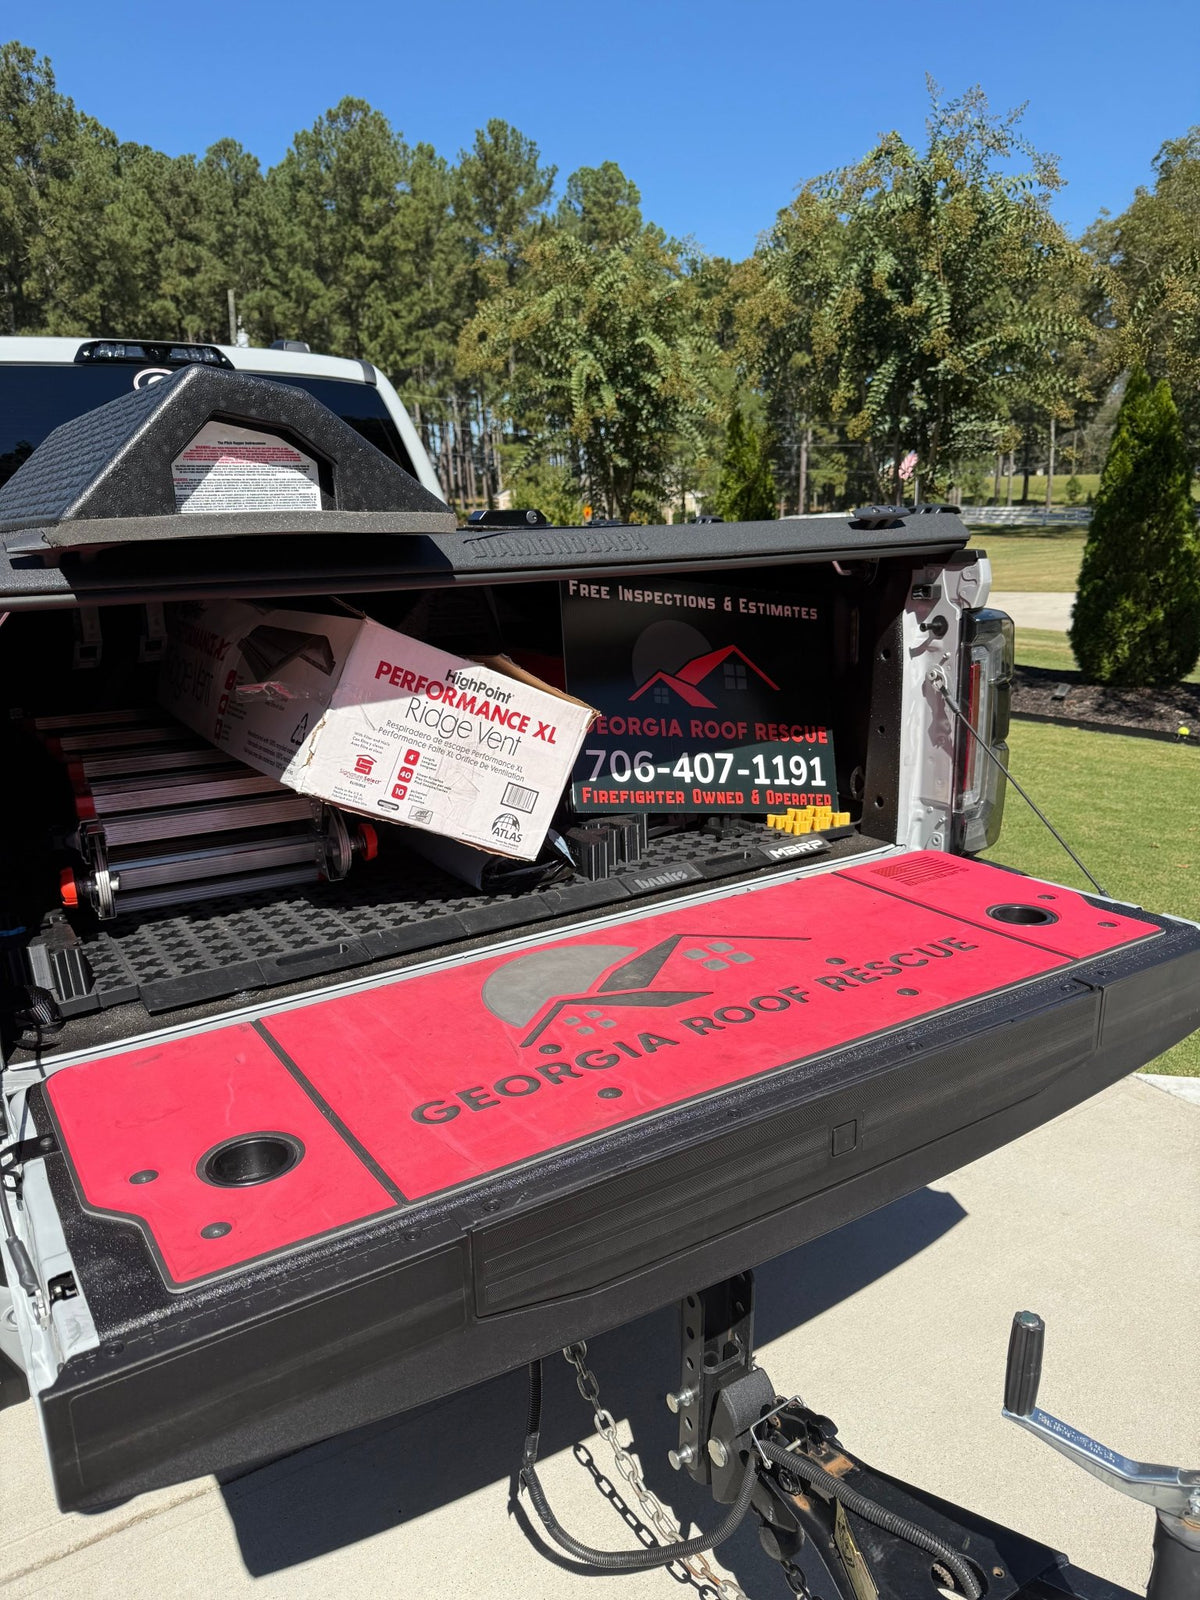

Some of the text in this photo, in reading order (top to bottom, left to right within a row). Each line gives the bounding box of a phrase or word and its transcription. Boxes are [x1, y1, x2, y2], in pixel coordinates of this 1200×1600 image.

[724, 597, 732, 612] &
[445, 669, 513, 705] HighPoint
[374, 660, 557, 745] PERFORMANCE XL
[405, 697, 522, 757] Ridge Vent
[586, 714, 828, 744] EORGIA ROOF RESCUE
[377, 726, 427, 748] Performance
[445, 748, 455, 759] XL
[455, 752, 479, 768] Orifice
[479, 760, 490, 772] De
[490, 764, 526, 783] Ventilation
[386, 720, 523, 774] Respiradero de escape Performance XL
[399, 771, 412, 780] 40
[585, 749, 827, 787] 706-407-1191
[394, 787, 405, 796] 10
[752, 789, 760, 805] &
[492, 827, 523, 843] ATLAS
[769, 839, 823, 859] MBRP
[633, 869, 688, 890] banks
[411, 936, 980, 1125] GEORGIA ROOF RESCUE
